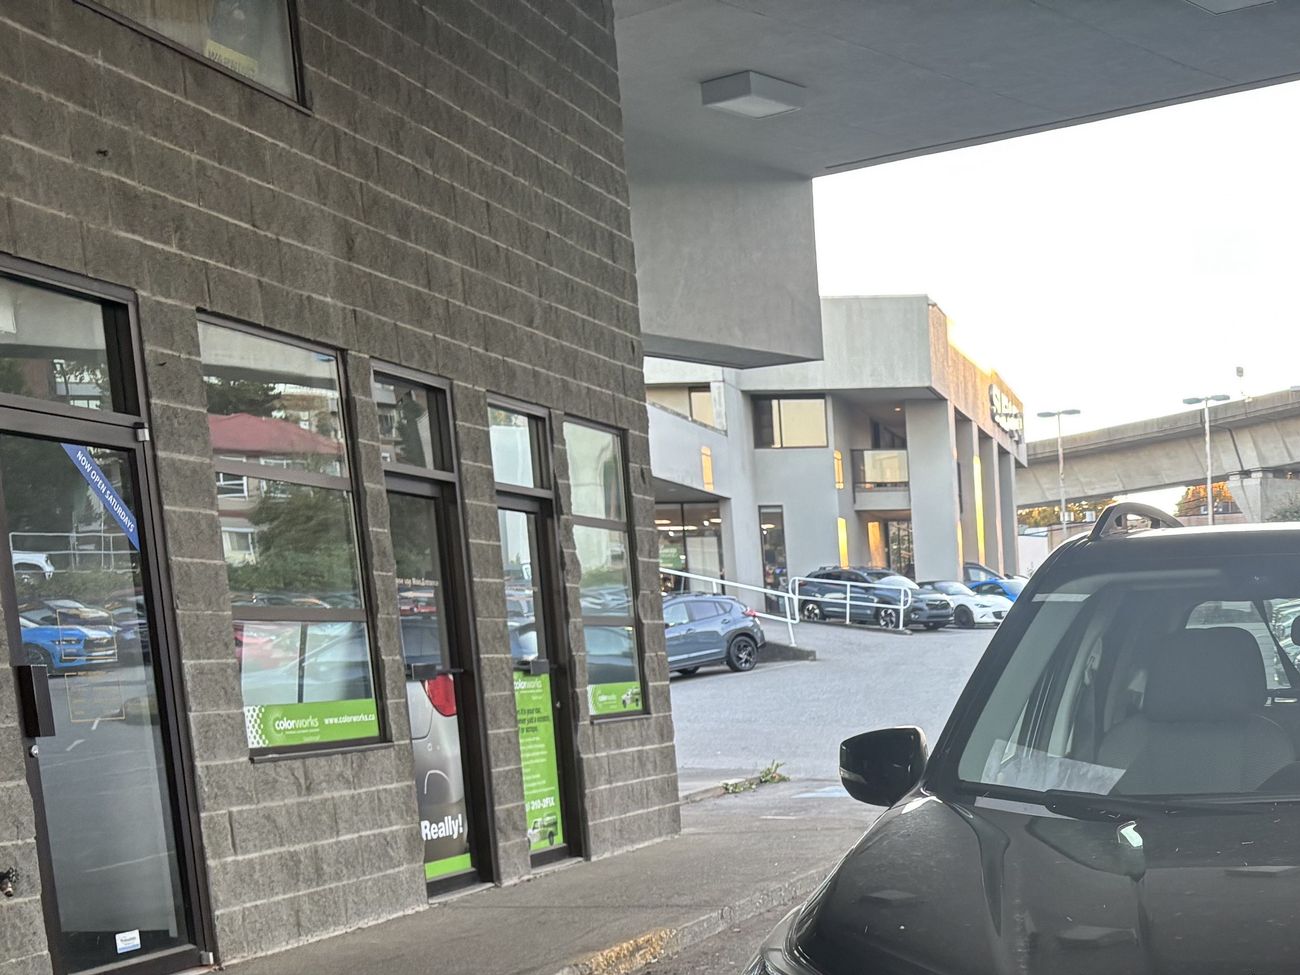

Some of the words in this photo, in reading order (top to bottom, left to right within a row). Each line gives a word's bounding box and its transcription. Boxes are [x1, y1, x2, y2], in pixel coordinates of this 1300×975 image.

[76, 450, 92, 473] NOW
[90, 470, 107, 493] OPEN
[104, 491, 135, 532] SATURDAYS
[274, 715, 319, 731] colorworks
[420, 813, 463, 841] Really!
